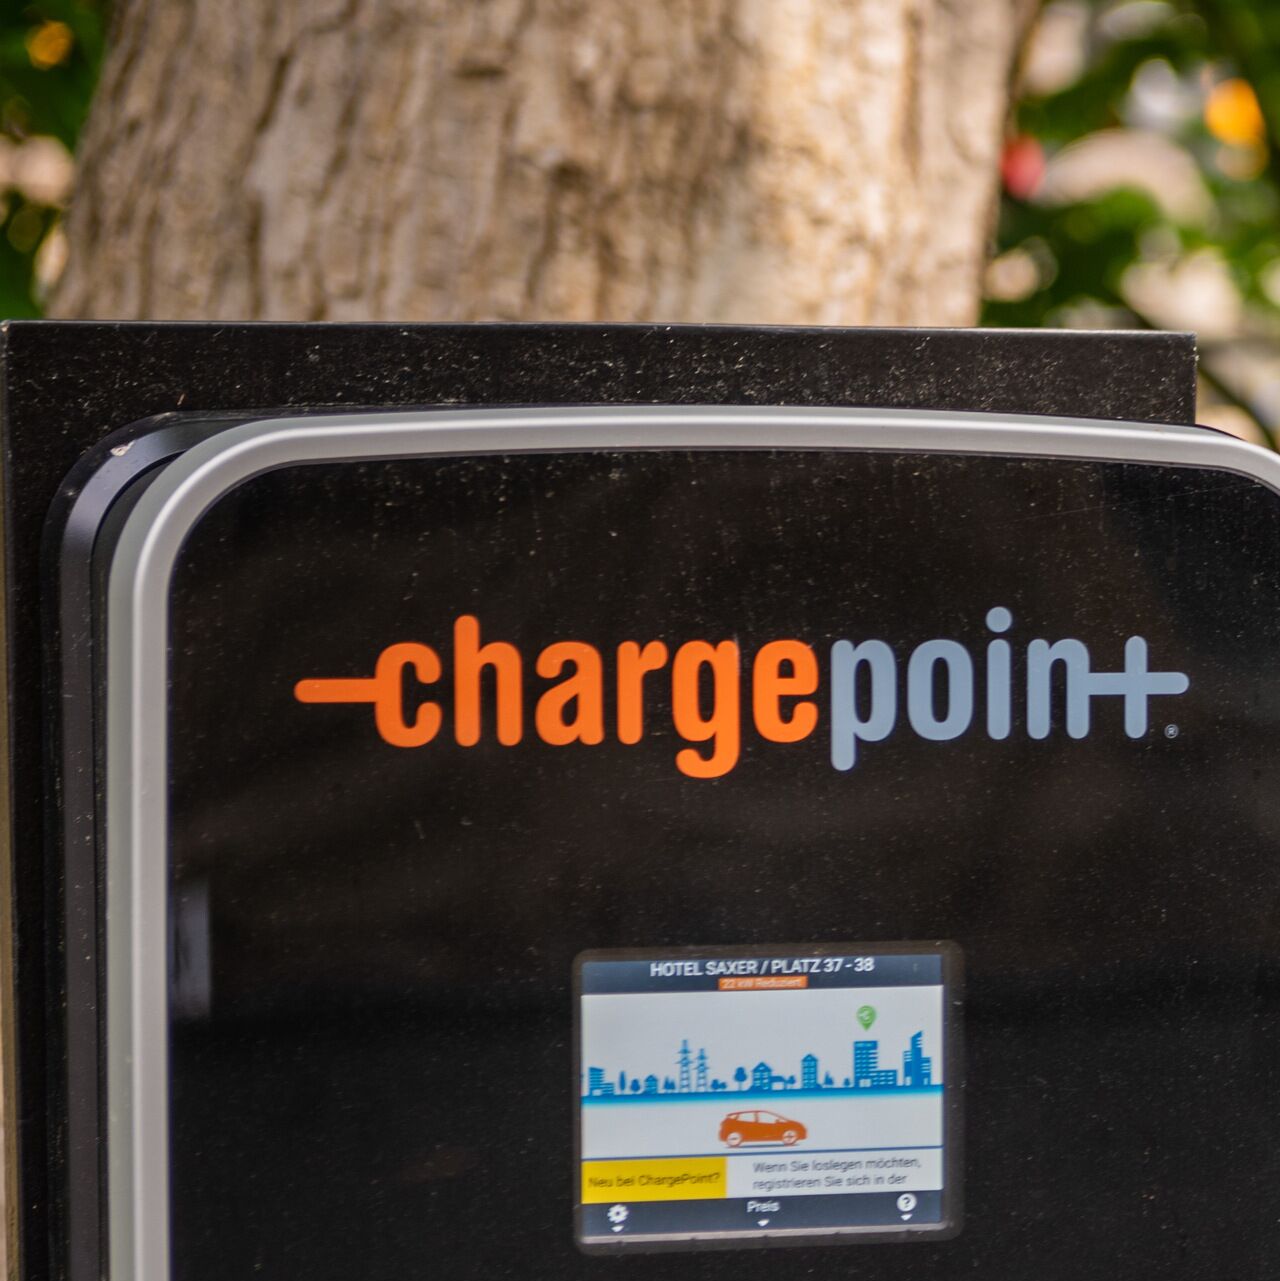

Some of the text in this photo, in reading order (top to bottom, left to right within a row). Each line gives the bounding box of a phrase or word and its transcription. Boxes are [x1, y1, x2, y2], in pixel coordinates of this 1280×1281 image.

[293, 606, 1191, 779] chargepoint
[650, 961, 703, 977] HOTEL
[705, 960, 759, 976] SAXER
[771, 959, 821, 973] PLATZ
[823, 958, 844, 972] 37
[854, 957, 875, 971] 38
[752, 1157, 921, 1173] Wenn Sie loslegen möchten,
[588, 1172, 720, 1187] Neu bei ChargePoint?
[753, 1173, 908, 1192] registrieren Sie sich in der
[747, 1201, 780, 1213] Preis
